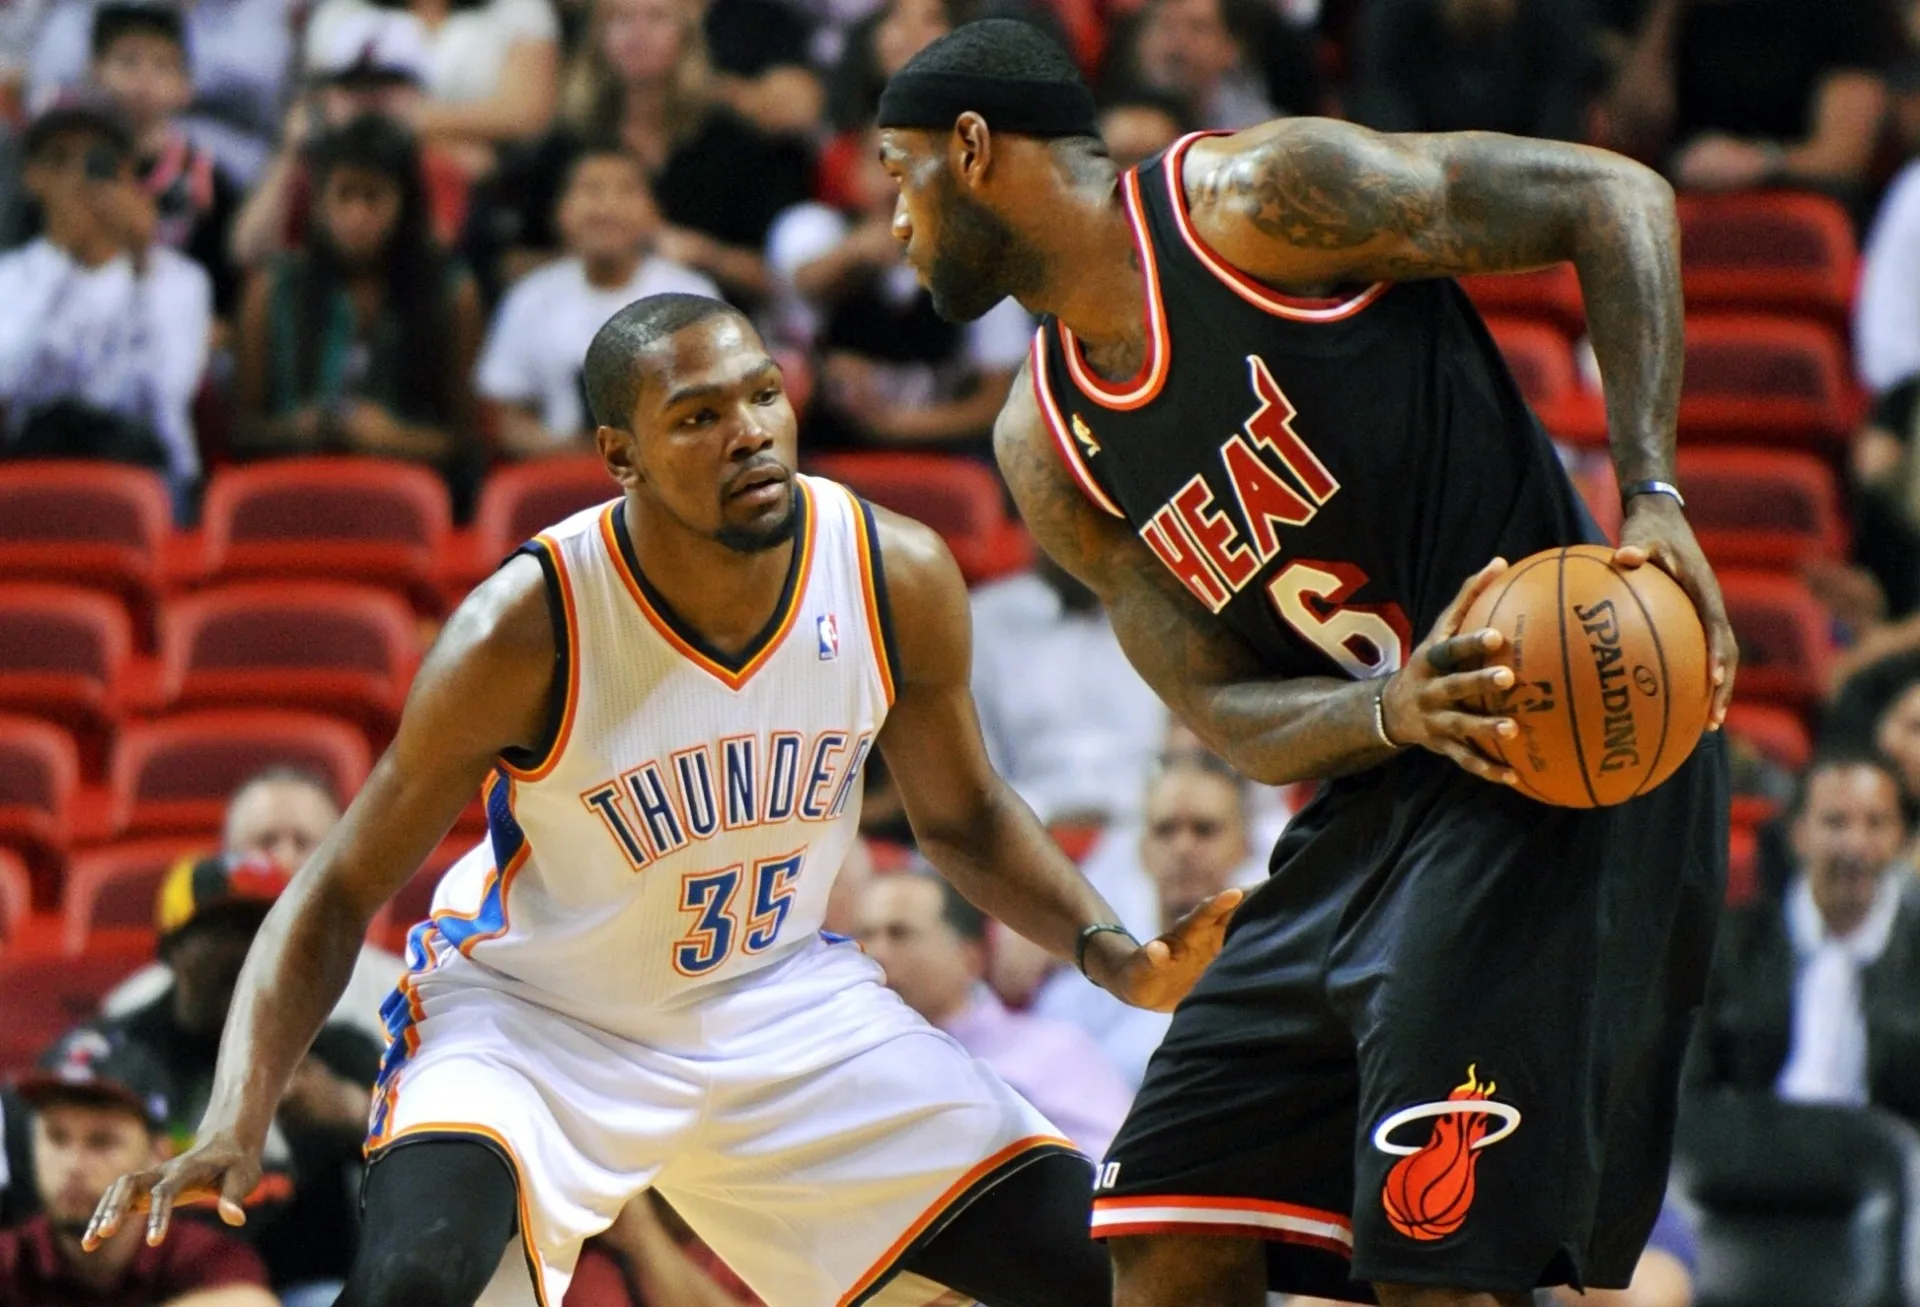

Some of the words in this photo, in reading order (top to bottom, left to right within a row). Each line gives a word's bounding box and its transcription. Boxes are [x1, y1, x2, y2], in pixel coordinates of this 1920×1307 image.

[1139, 355, 1341, 614] HEAT
[1265, 558, 1413, 681] 6
[1573, 599, 1641, 773] SPALDING
[671, 845, 809, 978] 35
